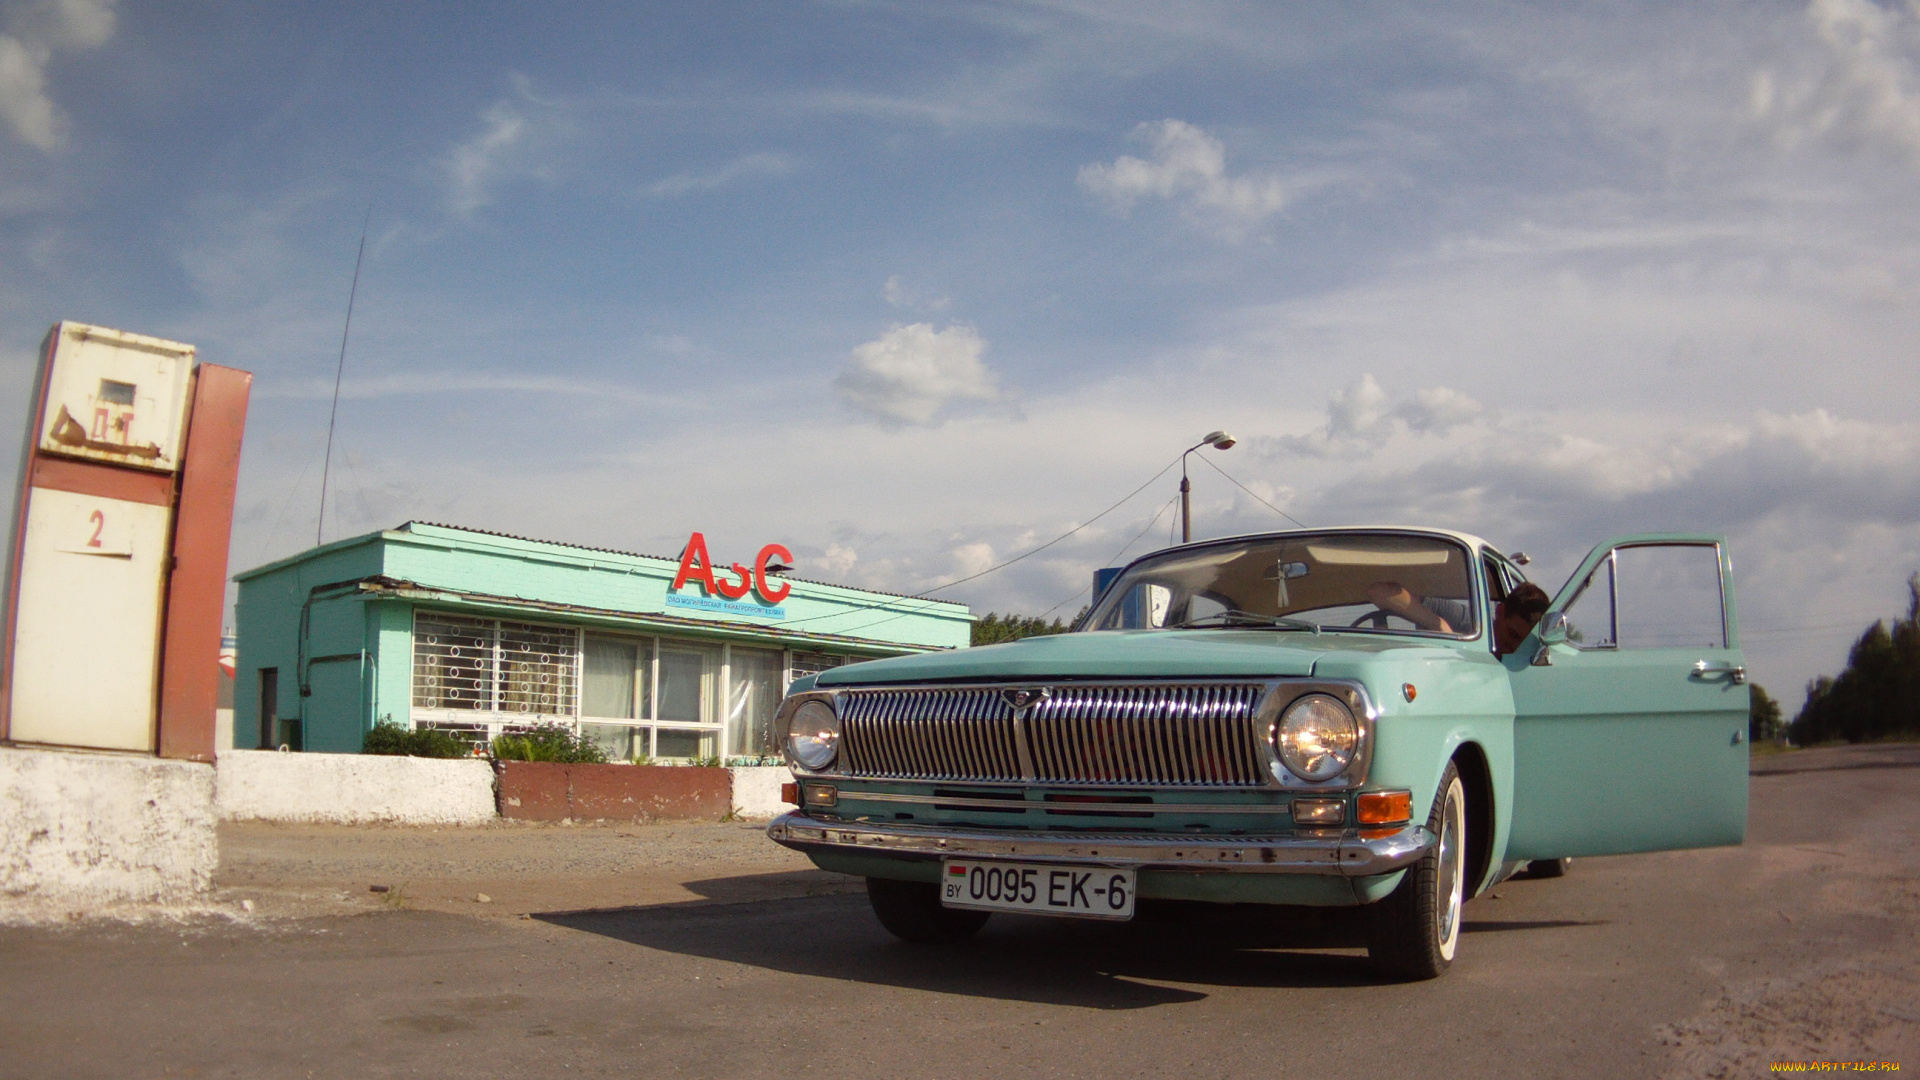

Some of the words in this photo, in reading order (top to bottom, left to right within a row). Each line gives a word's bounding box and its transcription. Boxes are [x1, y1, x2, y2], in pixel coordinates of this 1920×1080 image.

[87, 509, 104, 548] 2
[946, 884, 962, 898] BY
[970, 866, 1038, 904] 0095
[1048, 870, 1127, 910] EK-6
